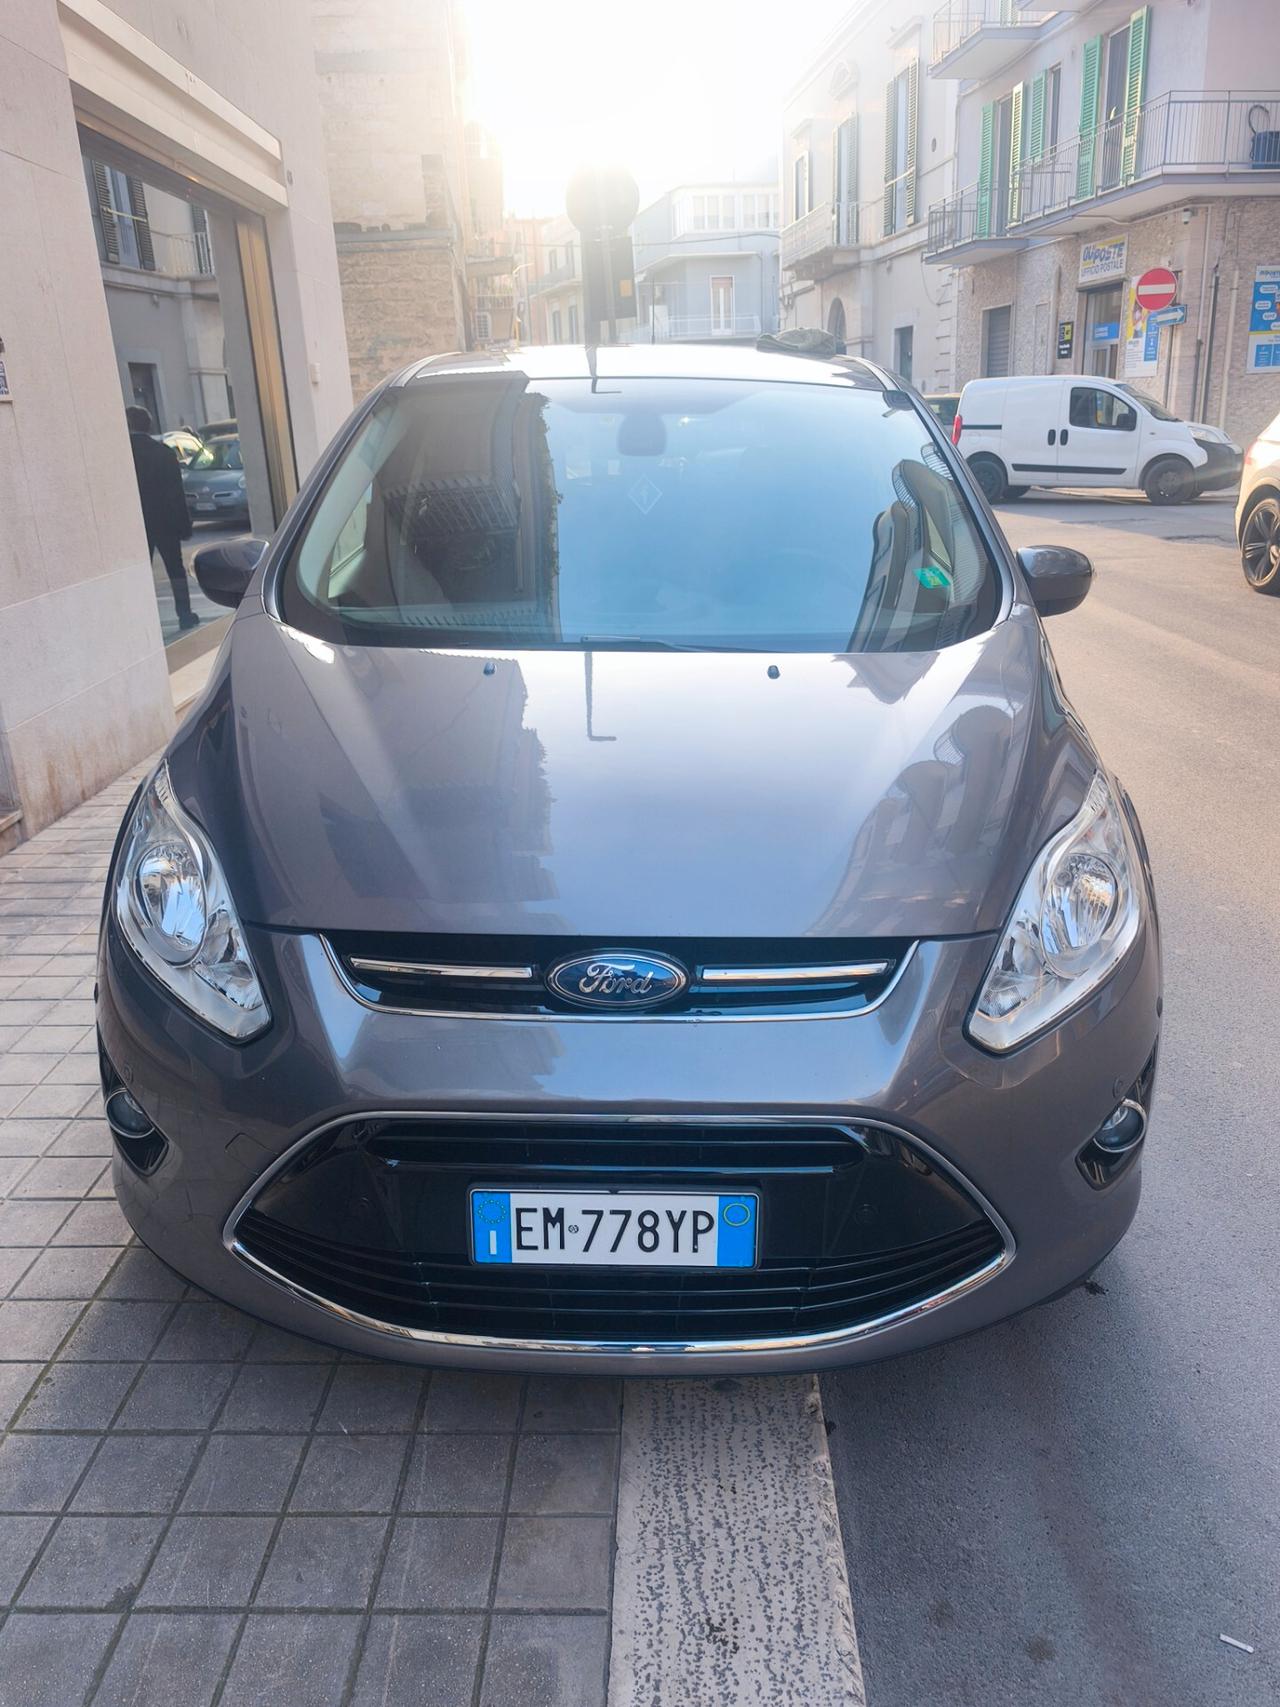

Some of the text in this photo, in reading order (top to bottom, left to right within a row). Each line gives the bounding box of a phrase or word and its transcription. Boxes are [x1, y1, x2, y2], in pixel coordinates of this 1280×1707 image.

[1100, 259, 1124, 273] POSTALE
[578, 962, 654, 994] Ford
[489, 1230, 497, 1255] I
